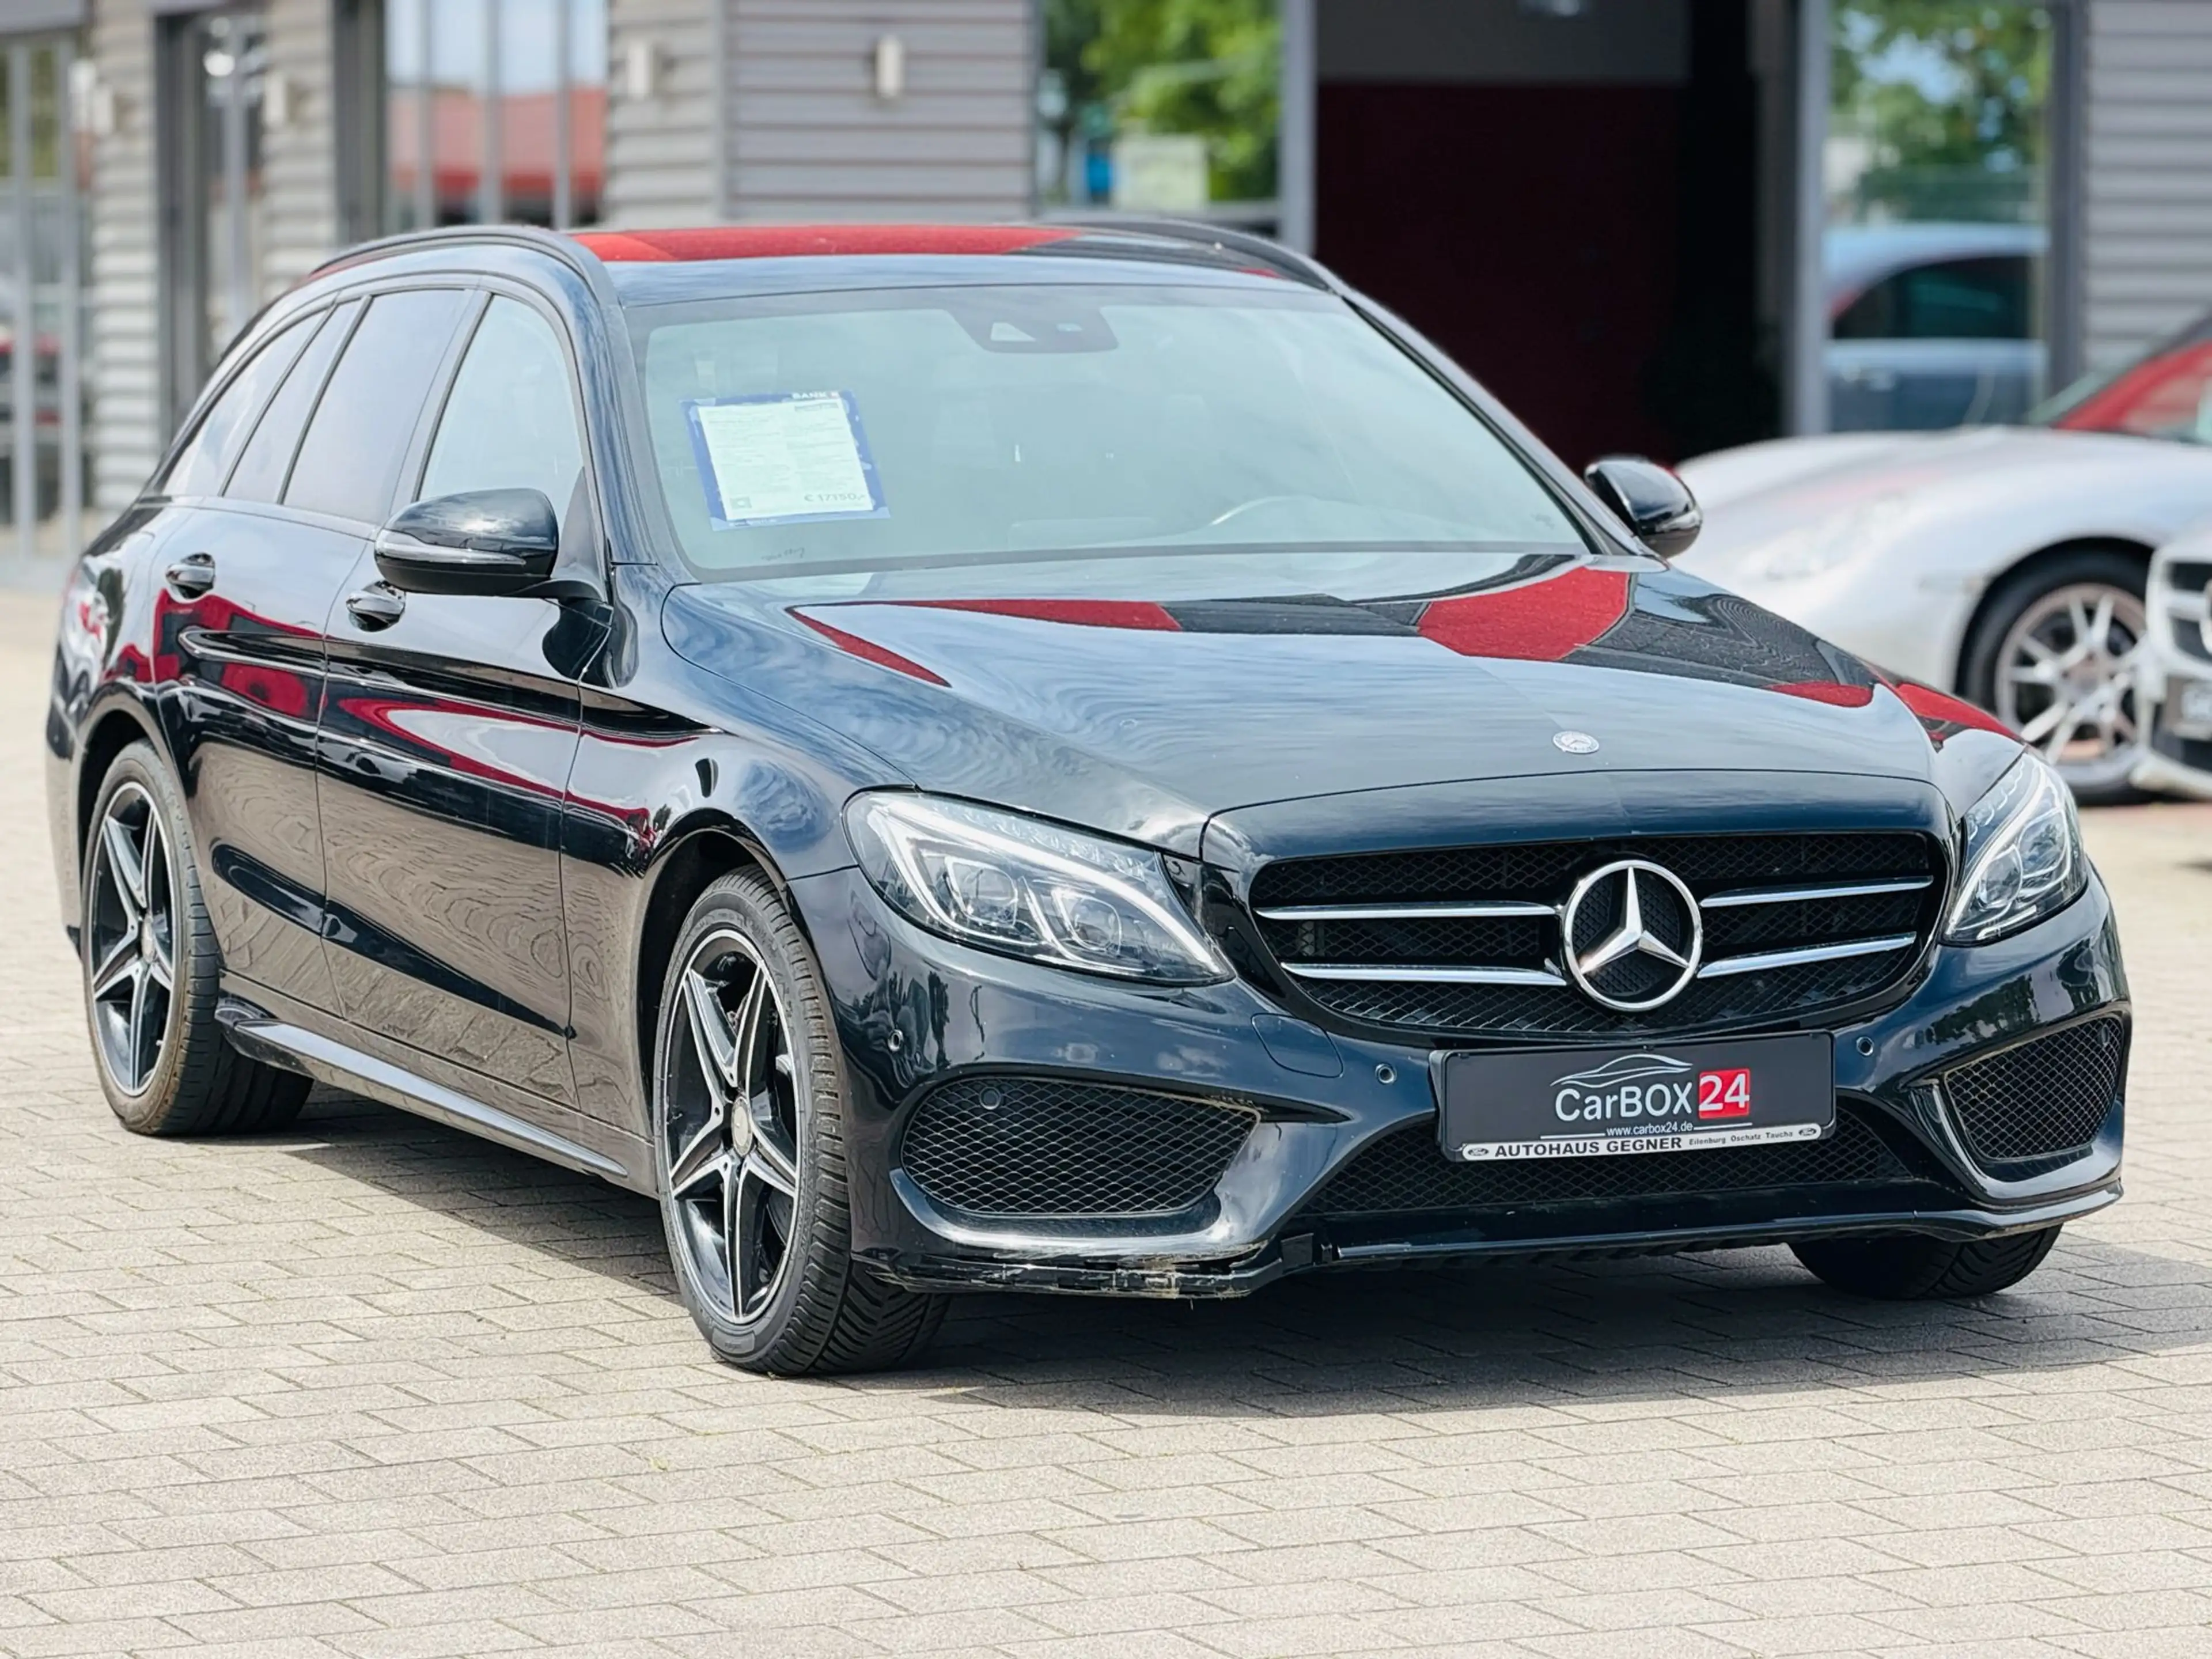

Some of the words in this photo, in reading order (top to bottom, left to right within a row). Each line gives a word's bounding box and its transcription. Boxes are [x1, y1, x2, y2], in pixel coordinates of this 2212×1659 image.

[1606, 1121, 1694, 1137] www.carbox24.de
[1495, 1142, 1600, 1157] AUTOHAUS
[1606, 1137, 1682, 1152] GEGNER
[1689, 1137, 1726, 1146] Eilenburg
[1730, 1133, 1761, 1142] Oschatz
[1766, 1131, 1793, 1139] Taucha
